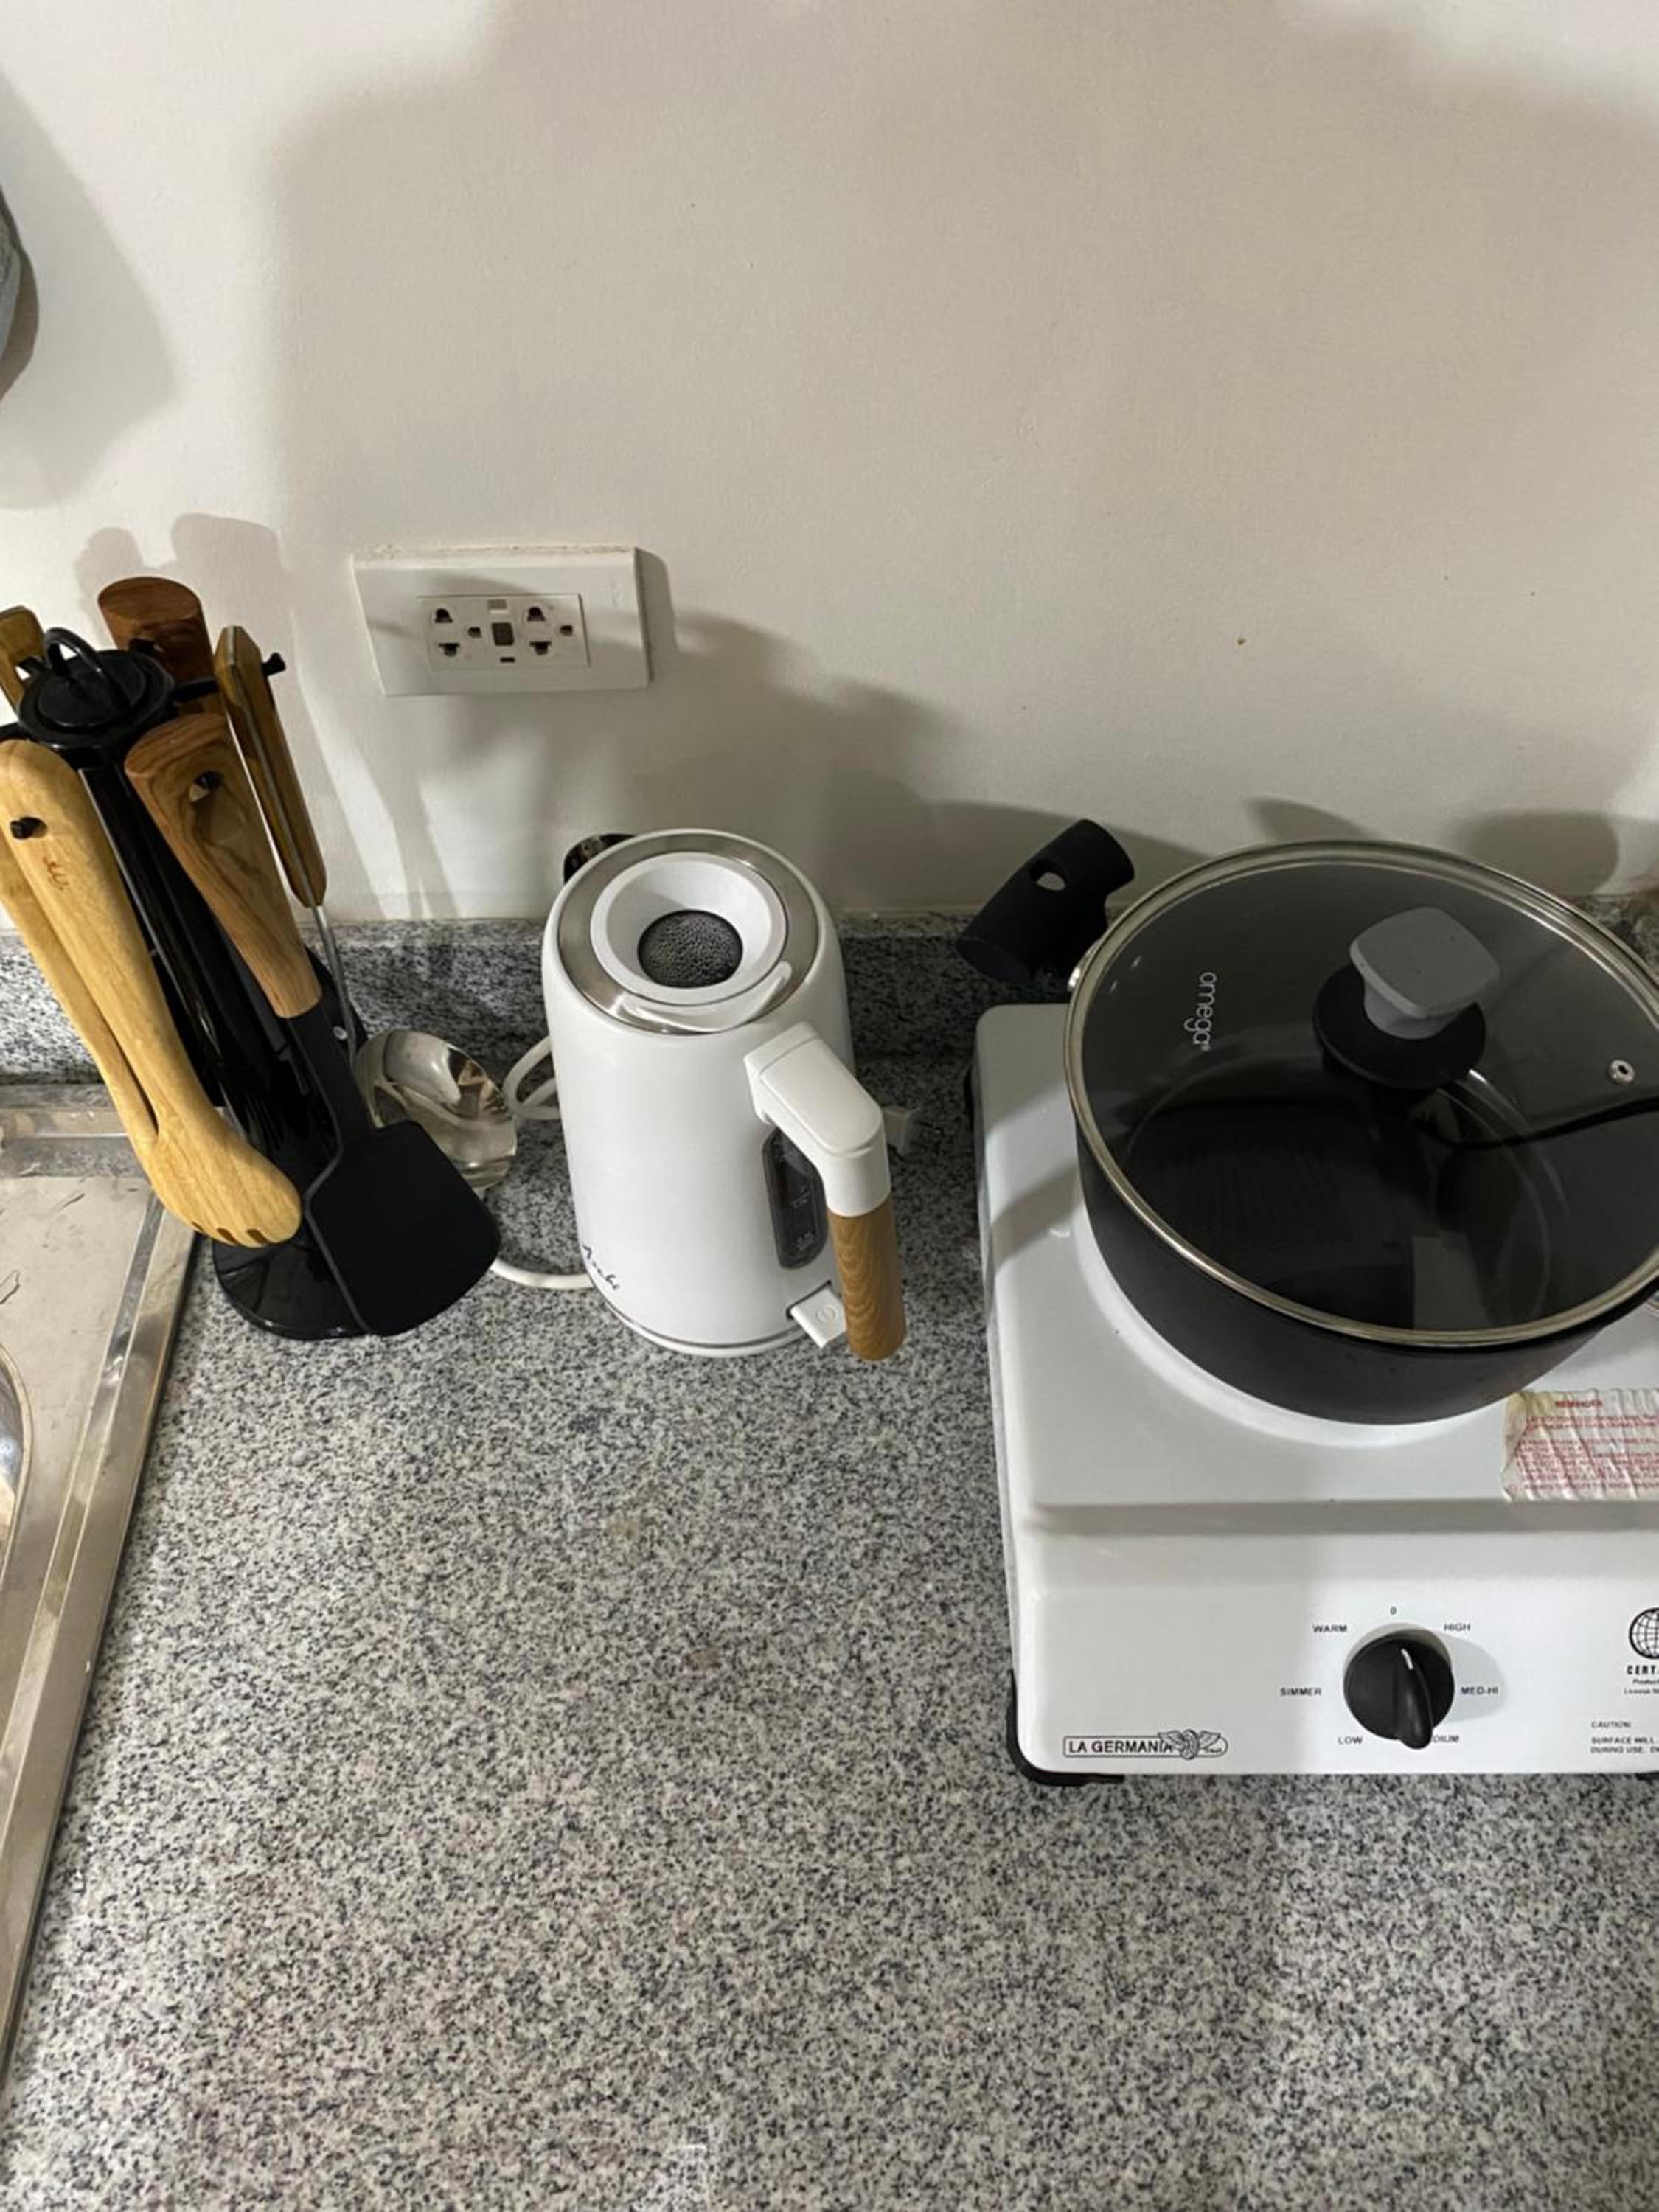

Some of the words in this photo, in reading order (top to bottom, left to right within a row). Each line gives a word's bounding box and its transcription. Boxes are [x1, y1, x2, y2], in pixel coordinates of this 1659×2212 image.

[1312, 1624, 1348, 1633] WARM
[1443, 1623, 1471, 1632] HIGH
[1627, 1664, 1659, 1675] CERT
[1280, 1688, 1321, 1697] SIMMER
[1460, 1686, 1499, 1695] MED-HI
[1338, 1736, 1363, 1745] LOW
[1433, 1735, 1460, 1743] DIUM
[1068, 1740, 1088, 1753] LA
[1091, 1740, 1173, 1753] GERMANIA
